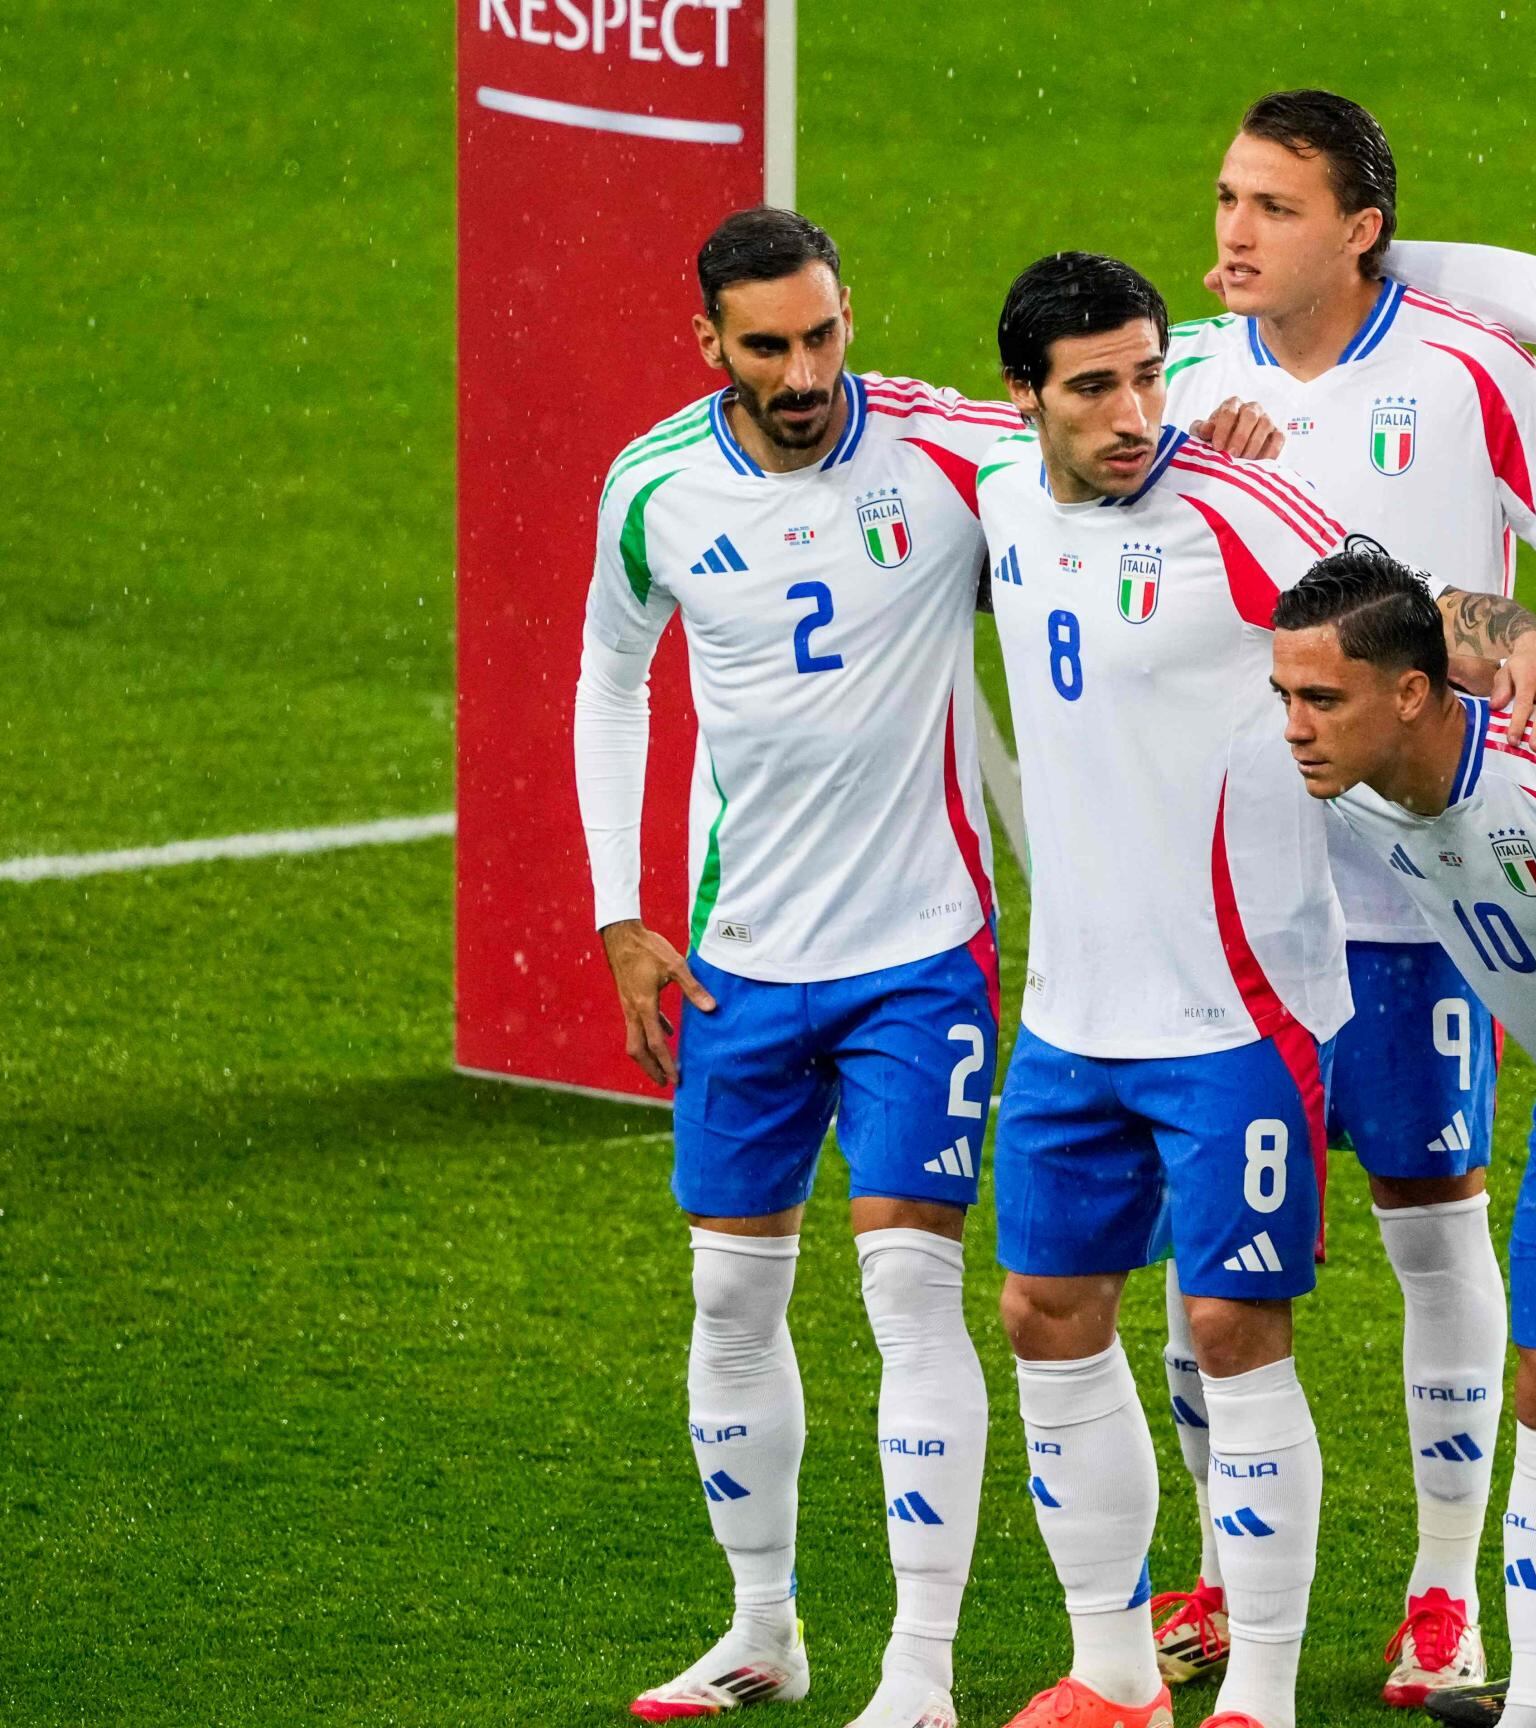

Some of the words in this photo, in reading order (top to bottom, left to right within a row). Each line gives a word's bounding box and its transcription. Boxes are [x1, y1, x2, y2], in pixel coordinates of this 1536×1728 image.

[1375, 413, 1411, 426] ITALIA
[861, 505, 900, 522] ITALIA
[1123, 558, 1157, 576] ITALIA
[787, 581, 844, 674] 2
[1047, 609, 1083, 702] 8
[1497, 845, 1531, 858] ITALIA
[1453, 899, 1536, 973] 10
[1432, 998, 1471, 1091] 9
[947, 1024, 985, 1119] 2
[1244, 1119, 1289, 1213] 8
[1412, 1385, 1487, 1403] ITALIA
[880, 1438, 945, 1456] TALIA
